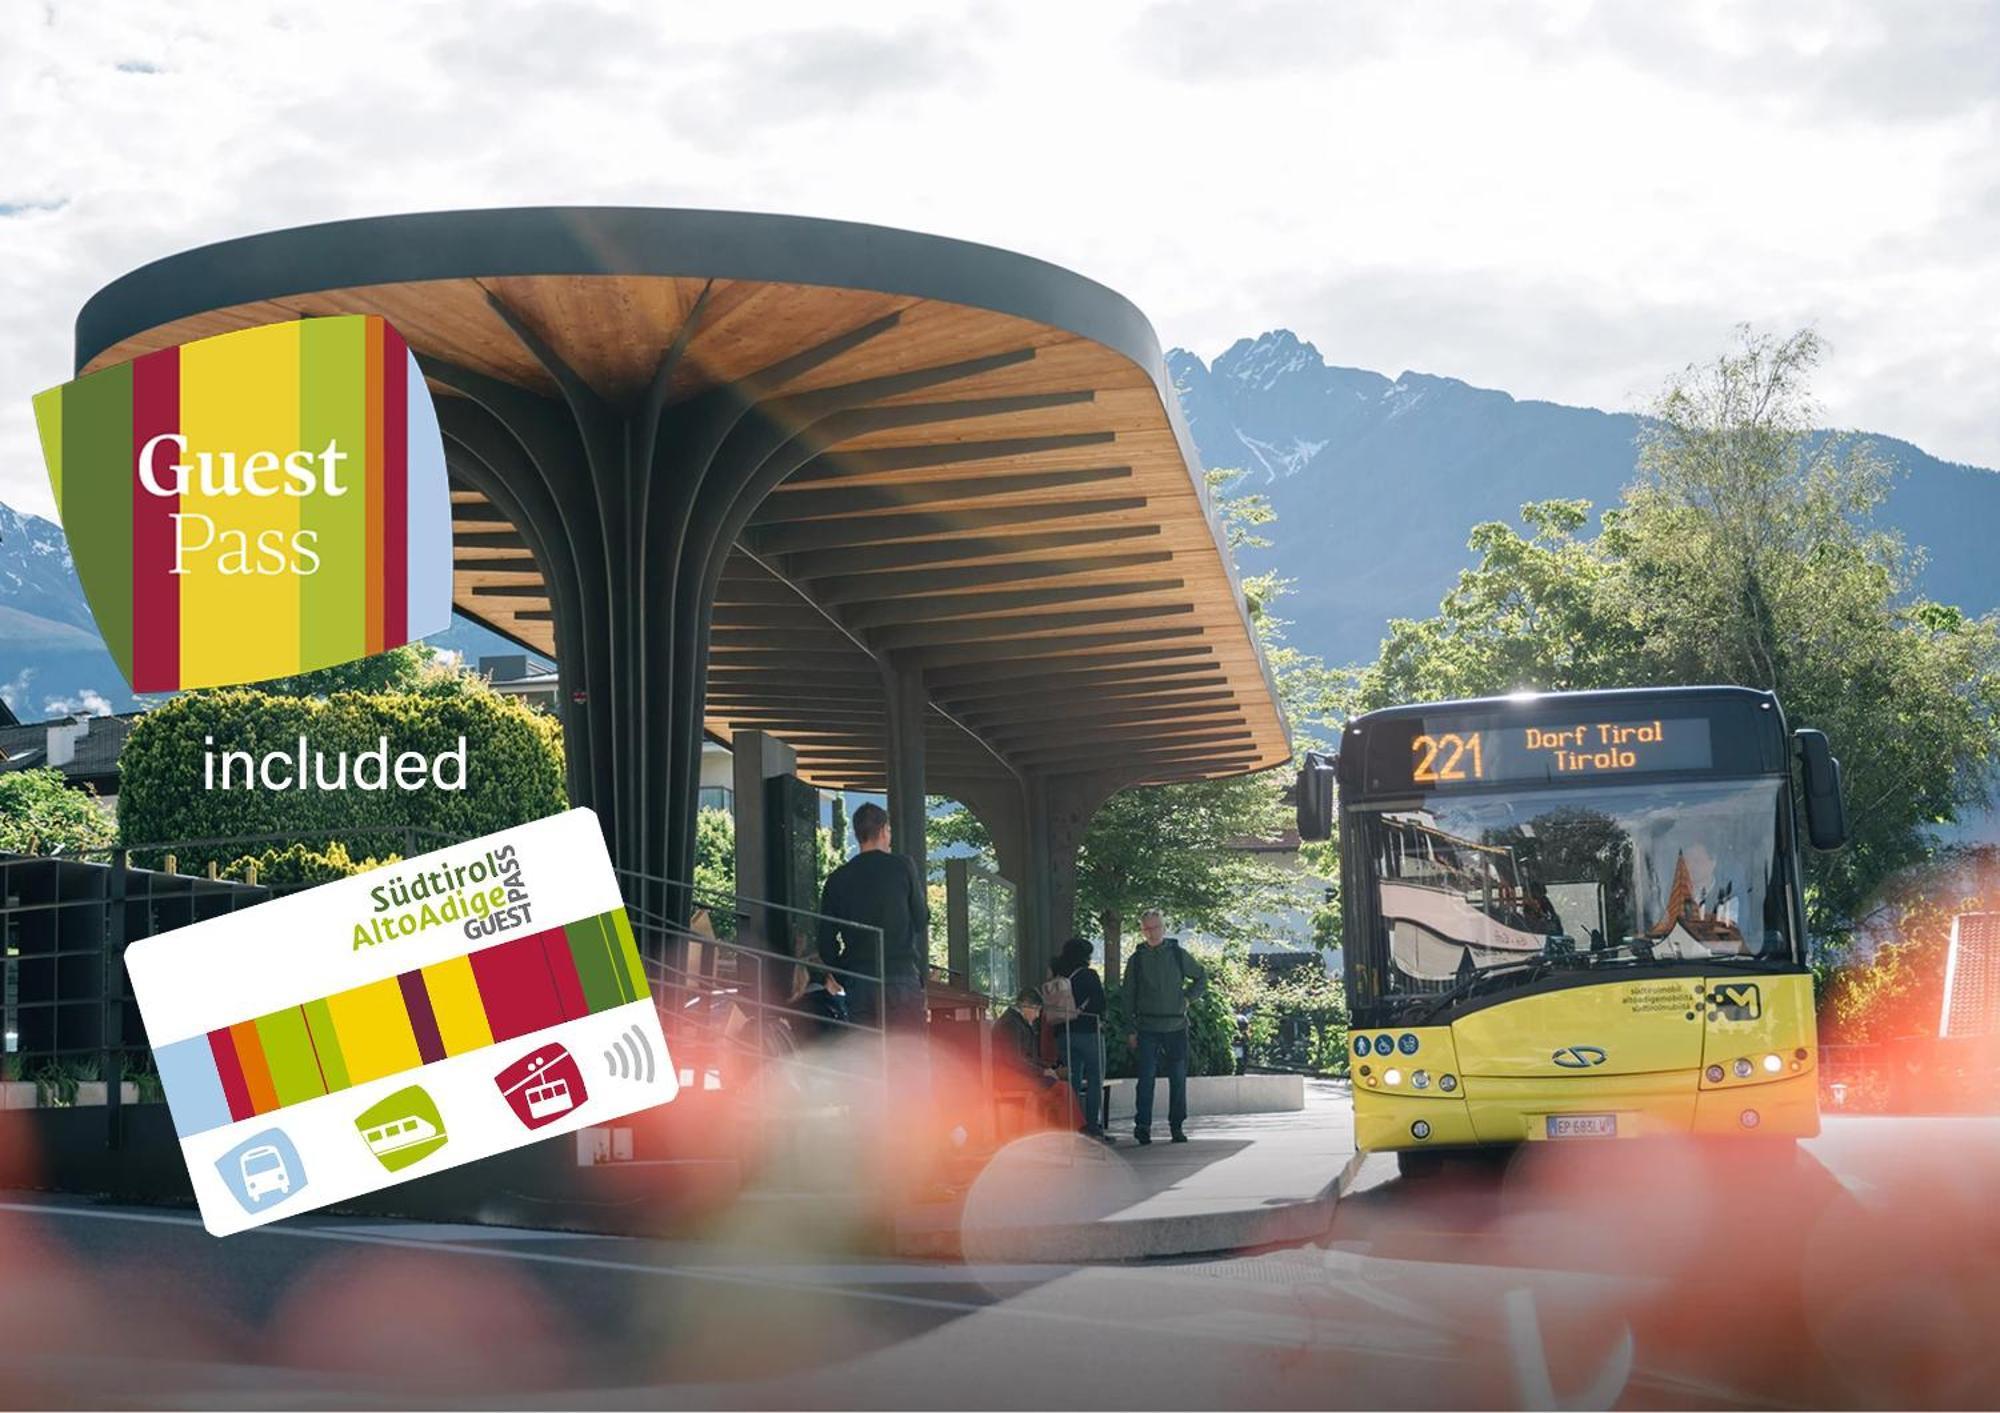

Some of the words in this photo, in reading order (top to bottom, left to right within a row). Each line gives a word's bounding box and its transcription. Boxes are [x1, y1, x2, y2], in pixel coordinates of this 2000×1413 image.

[1412, 732, 1483, 781] 221
[1525, 726, 1588, 749] Dorf
[1597, 721, 1663, 744] Tirol
[1554, 748, 1636, 770] Tirolo
